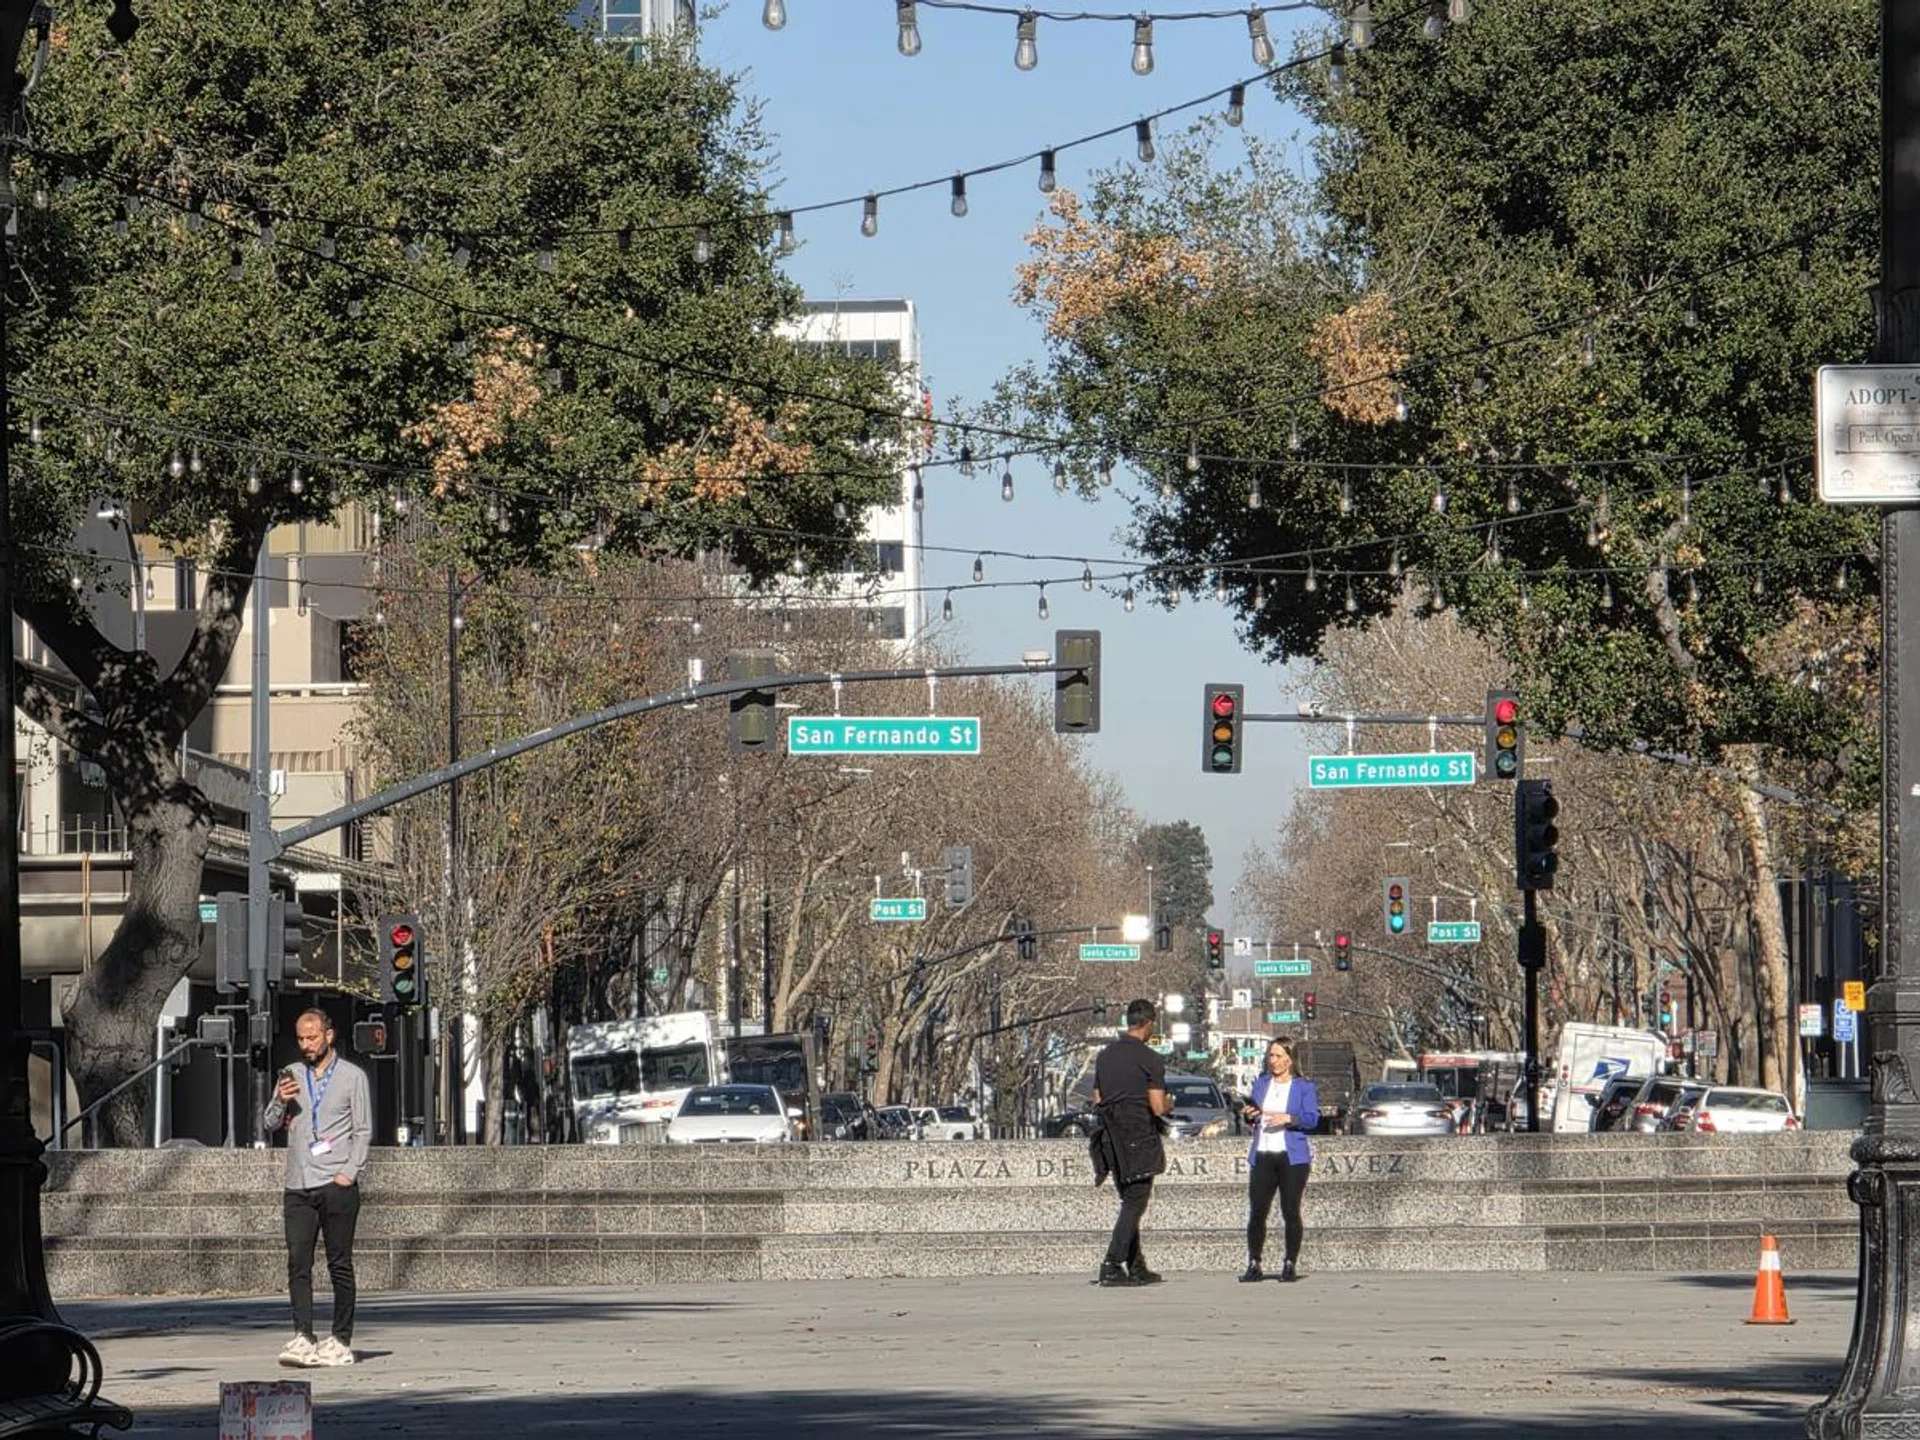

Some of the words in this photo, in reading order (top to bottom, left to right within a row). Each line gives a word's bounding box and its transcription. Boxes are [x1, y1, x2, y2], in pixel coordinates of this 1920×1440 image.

[1845, 388, 1920, 405] ADOPT-
[1859, 430, 1882, 444] Park
[1885, 431, 1913, 446] Open
[796, 726, 834, 744] San
[844, 726, 940, 745] Fernando
[950, 726, 972, 744] St
[1315, 764, 1348, 780] San
[1357, 761, 1440, 779] Fernando
[1448, 760, 1468, 776] St
[874, 904, 902, 916] Post
[908, 904, 923, 915] St
[1431, 927, 1457, 939] Post
[1464, 926, 1478, 938] St
[906, 1159, 1012, 1179] PLAZA
[1036, 1158, 1076, 1177] DE
[1320, 1154, 1405, 1175] AVEZ
